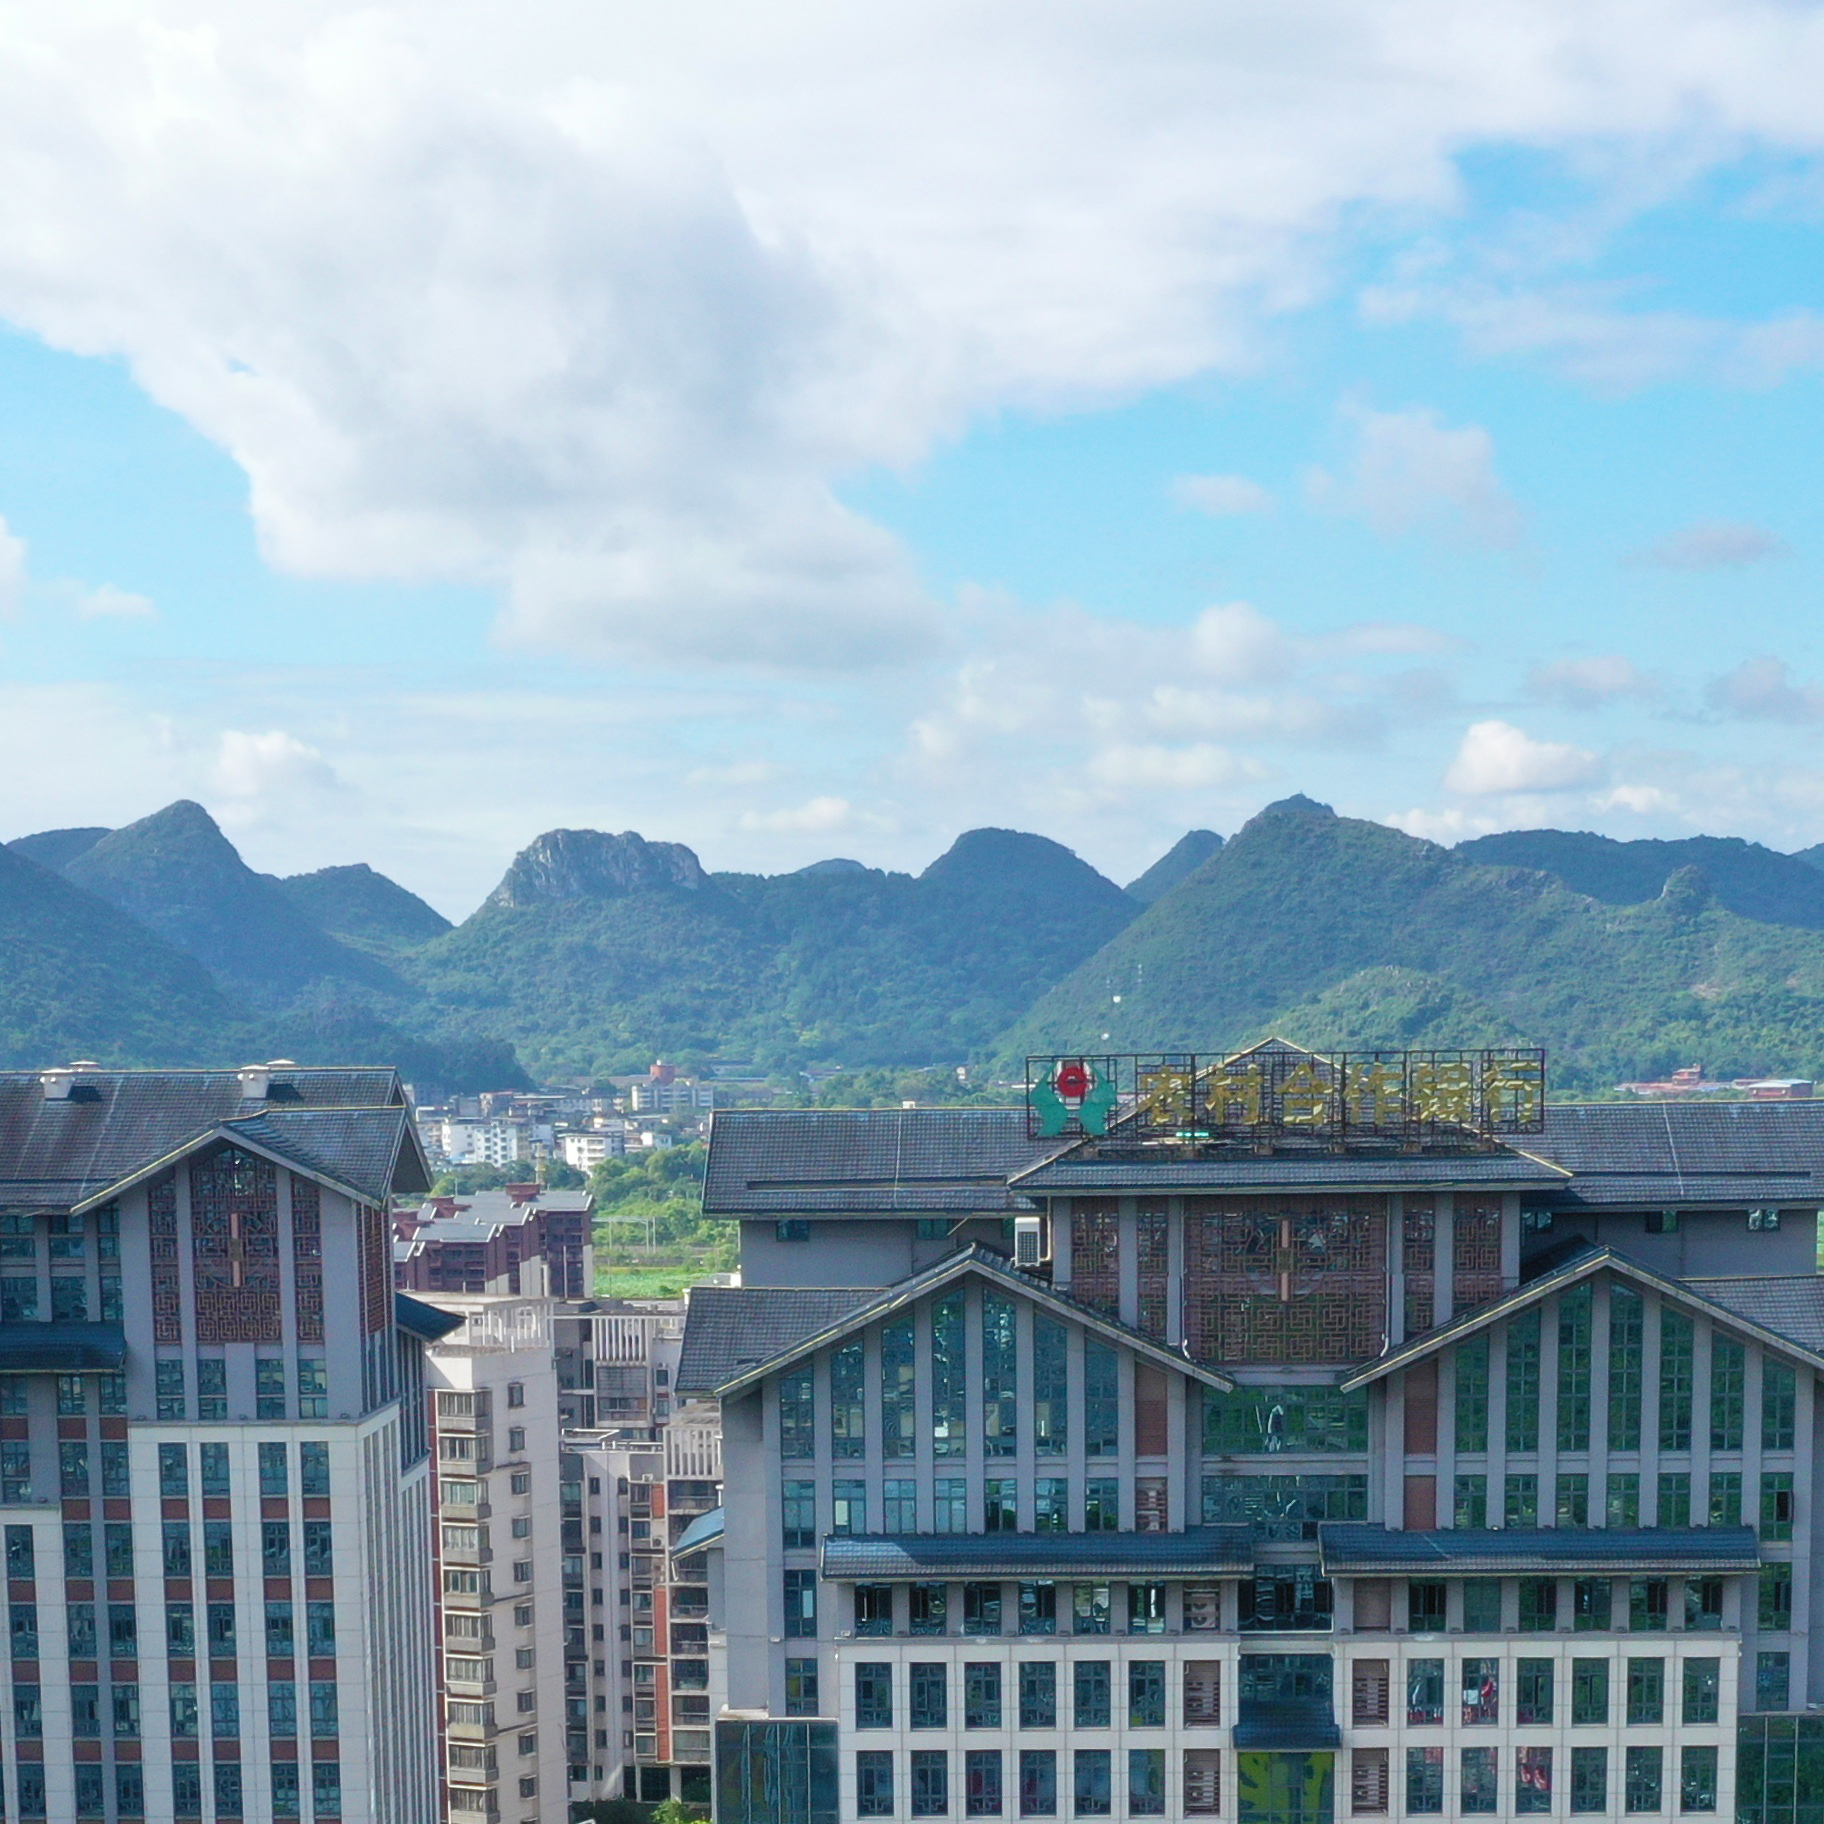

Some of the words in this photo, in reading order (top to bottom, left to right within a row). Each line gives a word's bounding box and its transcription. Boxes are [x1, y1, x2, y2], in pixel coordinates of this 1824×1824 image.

[1142, 1060, 1544, 1127] 农村合作银行
